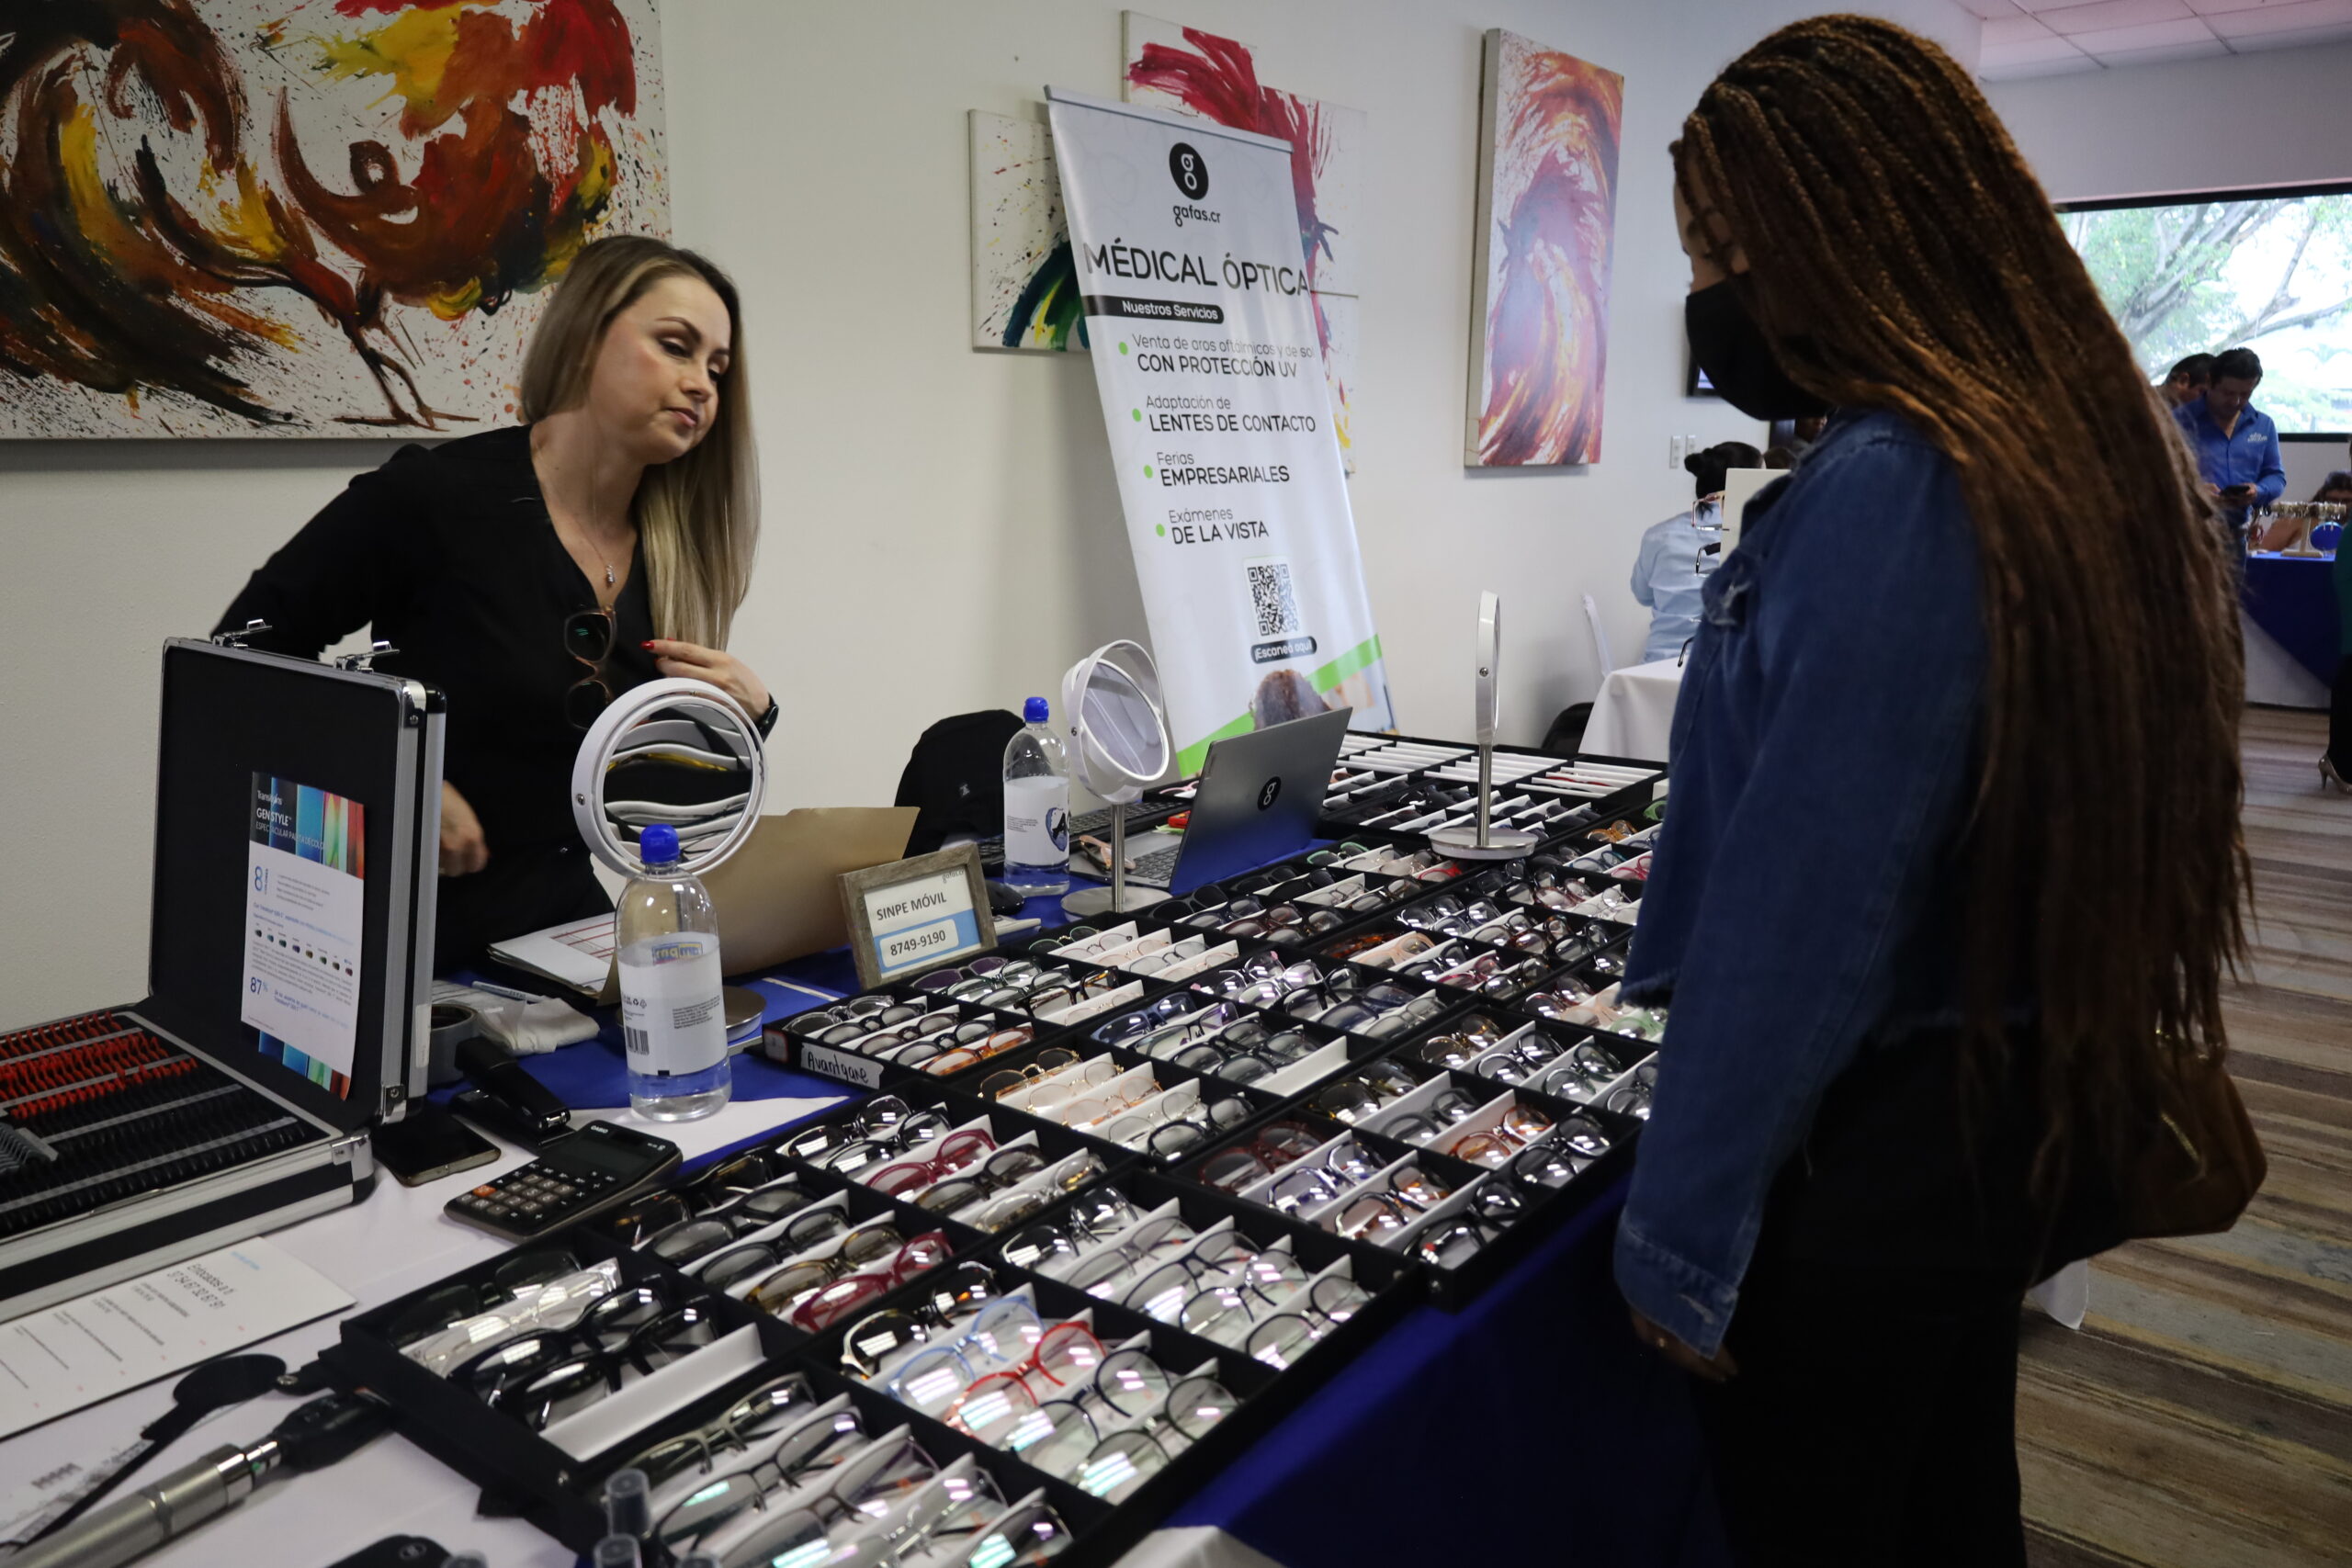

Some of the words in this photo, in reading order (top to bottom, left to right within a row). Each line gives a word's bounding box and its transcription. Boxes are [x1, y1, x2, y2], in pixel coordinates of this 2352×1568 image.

[1173, 204, 1221, 228] gafas.cr
[1083, 238, 1217, 287] MÉDICAL
[1222, 252, 1312, 296] ÓPTICA
[1122, 300, 1171, 317] Nuestros
[1174, 305, 1218, 320] Servicios
[1133, 333, 1170, 350] Venta
[1174, 336, 1188, 350] de
[1192, 339, 1216, 351] aros
[1137, 354, 1175, 372] CON
[1179, 355, 1276, 377] PROTECCIÓN
[1279, 362, 1296, 377] UV
[1147, 395, 1215, 411] Adaptación
[1217, 397, 1231, 411] de
[1149, 413, 1214, 432] LENTES
[1218, 415, 1239, 432] DE
[1242, 415, 1316, 433] CONTACTO
[1157, 451, 1194, 466] Ferias
[1160, 465, 1290, 487] EMPRESARIALES
[1169, 507, 1233, 524] Exámenes
[1171, 525, 1195, 545] DE
[1200, 525, 1223, 543] LA
[1225, 521, 1269, 540] VISTA
[254, 865, 264, 892] 8
[876, 902, 910, 921] SINPE
[910, 892, 947, 911] MÓVIL
[890, 930, 946, 956] 8749-9190
